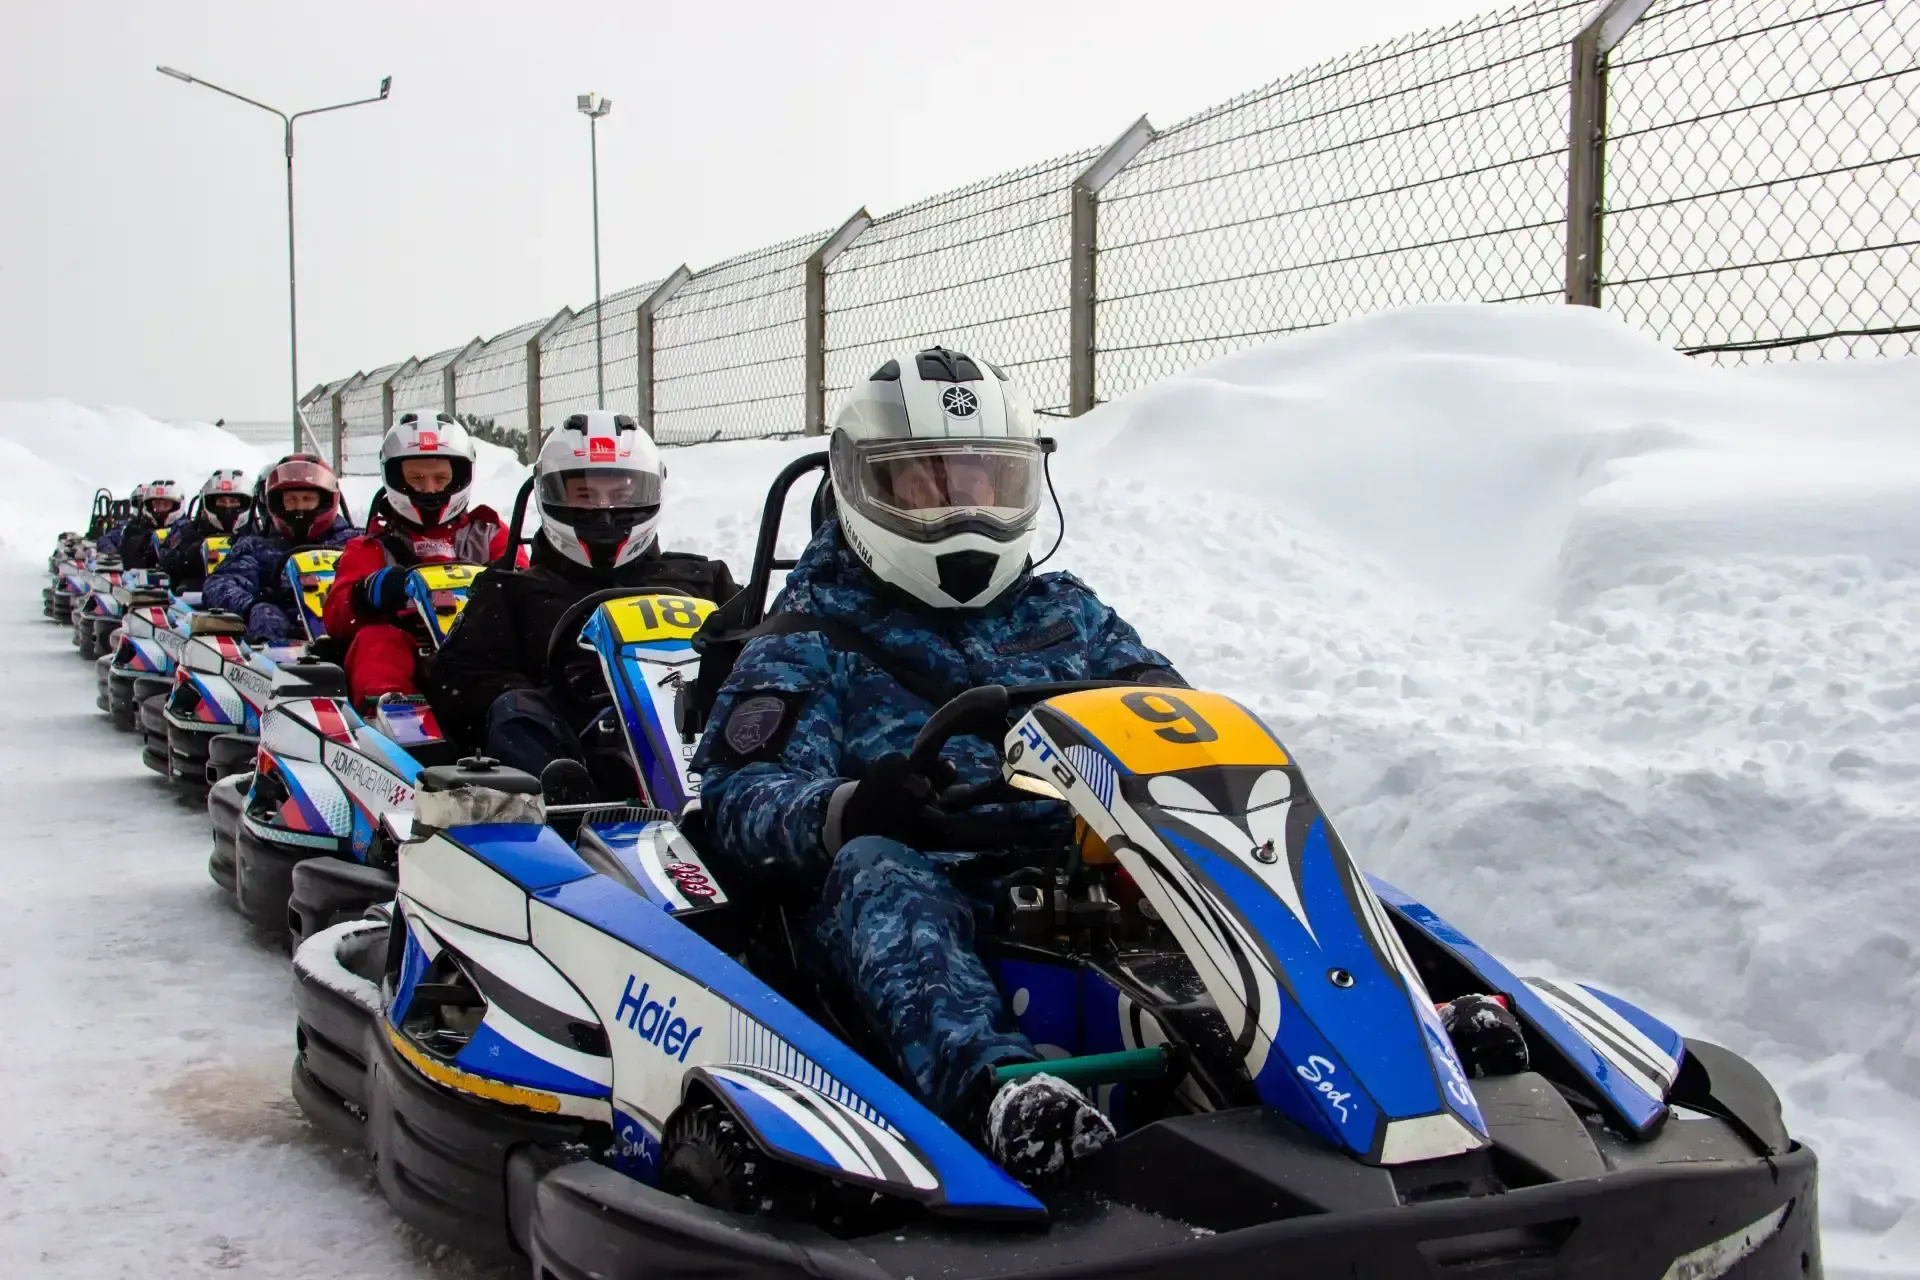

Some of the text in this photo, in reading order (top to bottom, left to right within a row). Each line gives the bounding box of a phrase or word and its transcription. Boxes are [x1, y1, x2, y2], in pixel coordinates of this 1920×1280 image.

[845, 515, 873, 568] YAMAHA
[443, 564, 473, 580] 5
[627, 598, 702, 630] 18
[1120, 691, 1219, 744] 9
[615, 973, 704, 1063] Haier
[1296, 1055, 1358, 1124] Sodi
